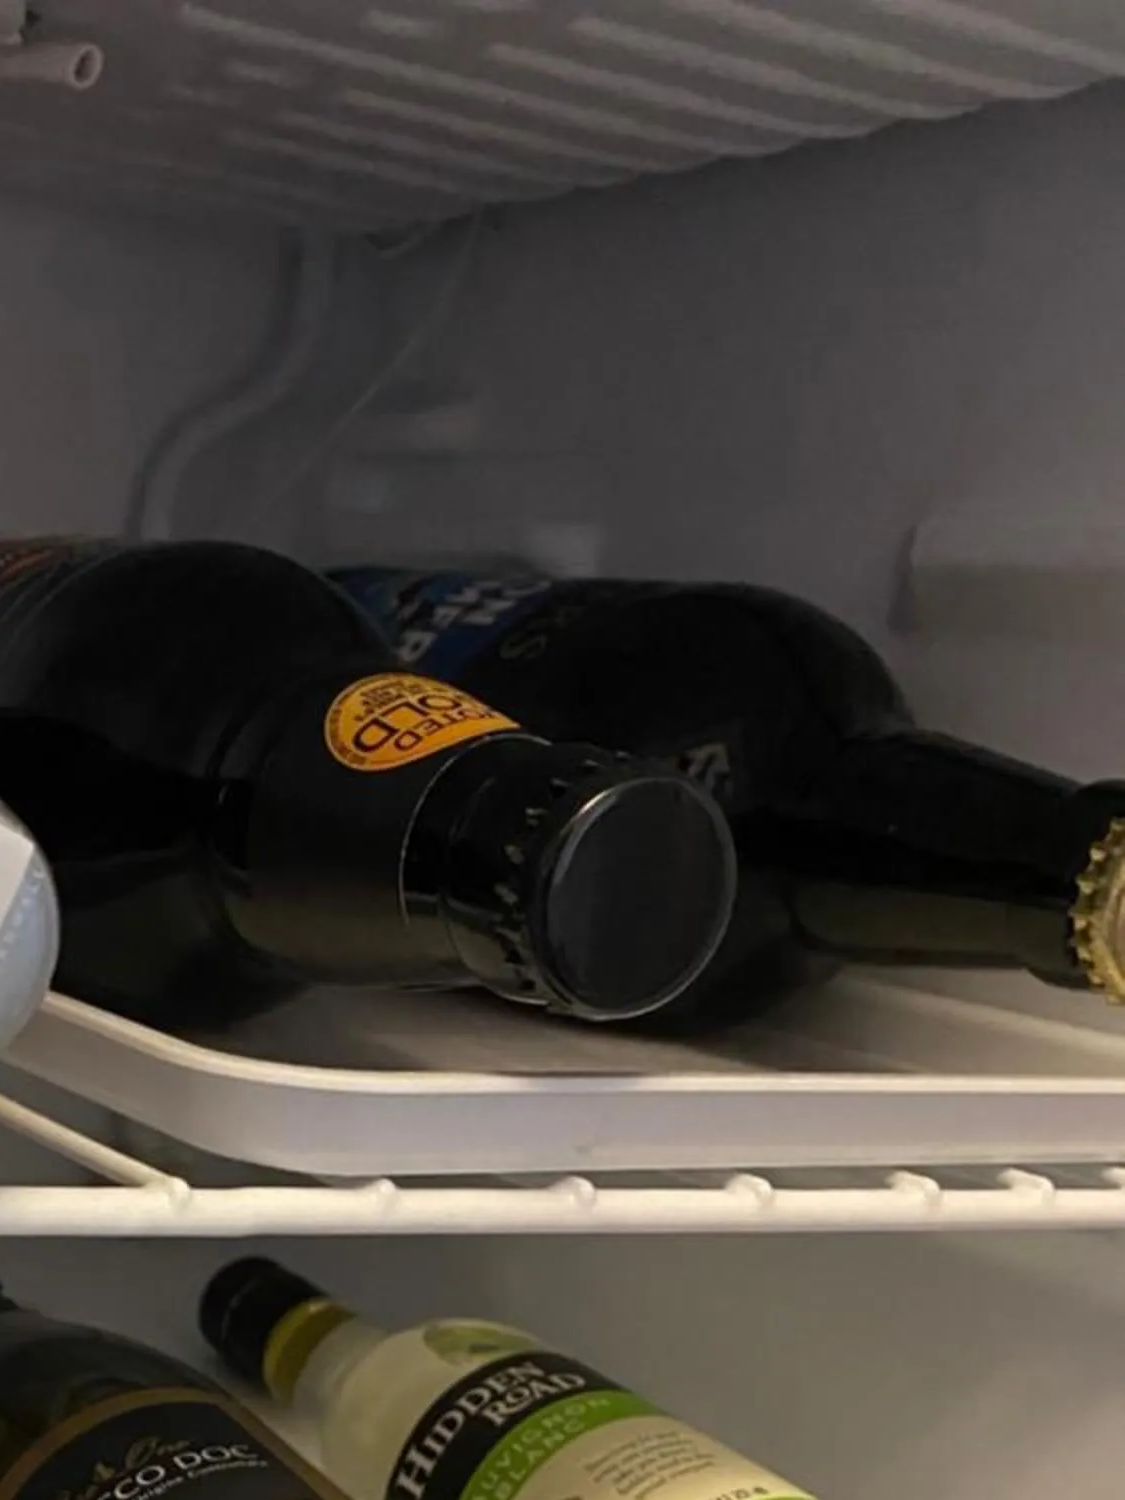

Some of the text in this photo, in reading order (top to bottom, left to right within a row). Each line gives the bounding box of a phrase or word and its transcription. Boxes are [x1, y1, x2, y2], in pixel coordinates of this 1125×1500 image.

[483, 1372, 586, 1428] ROAD
[173, 1442, 260, 1471] DOC
[396, 1361, 545, 1500] HIDDEN
